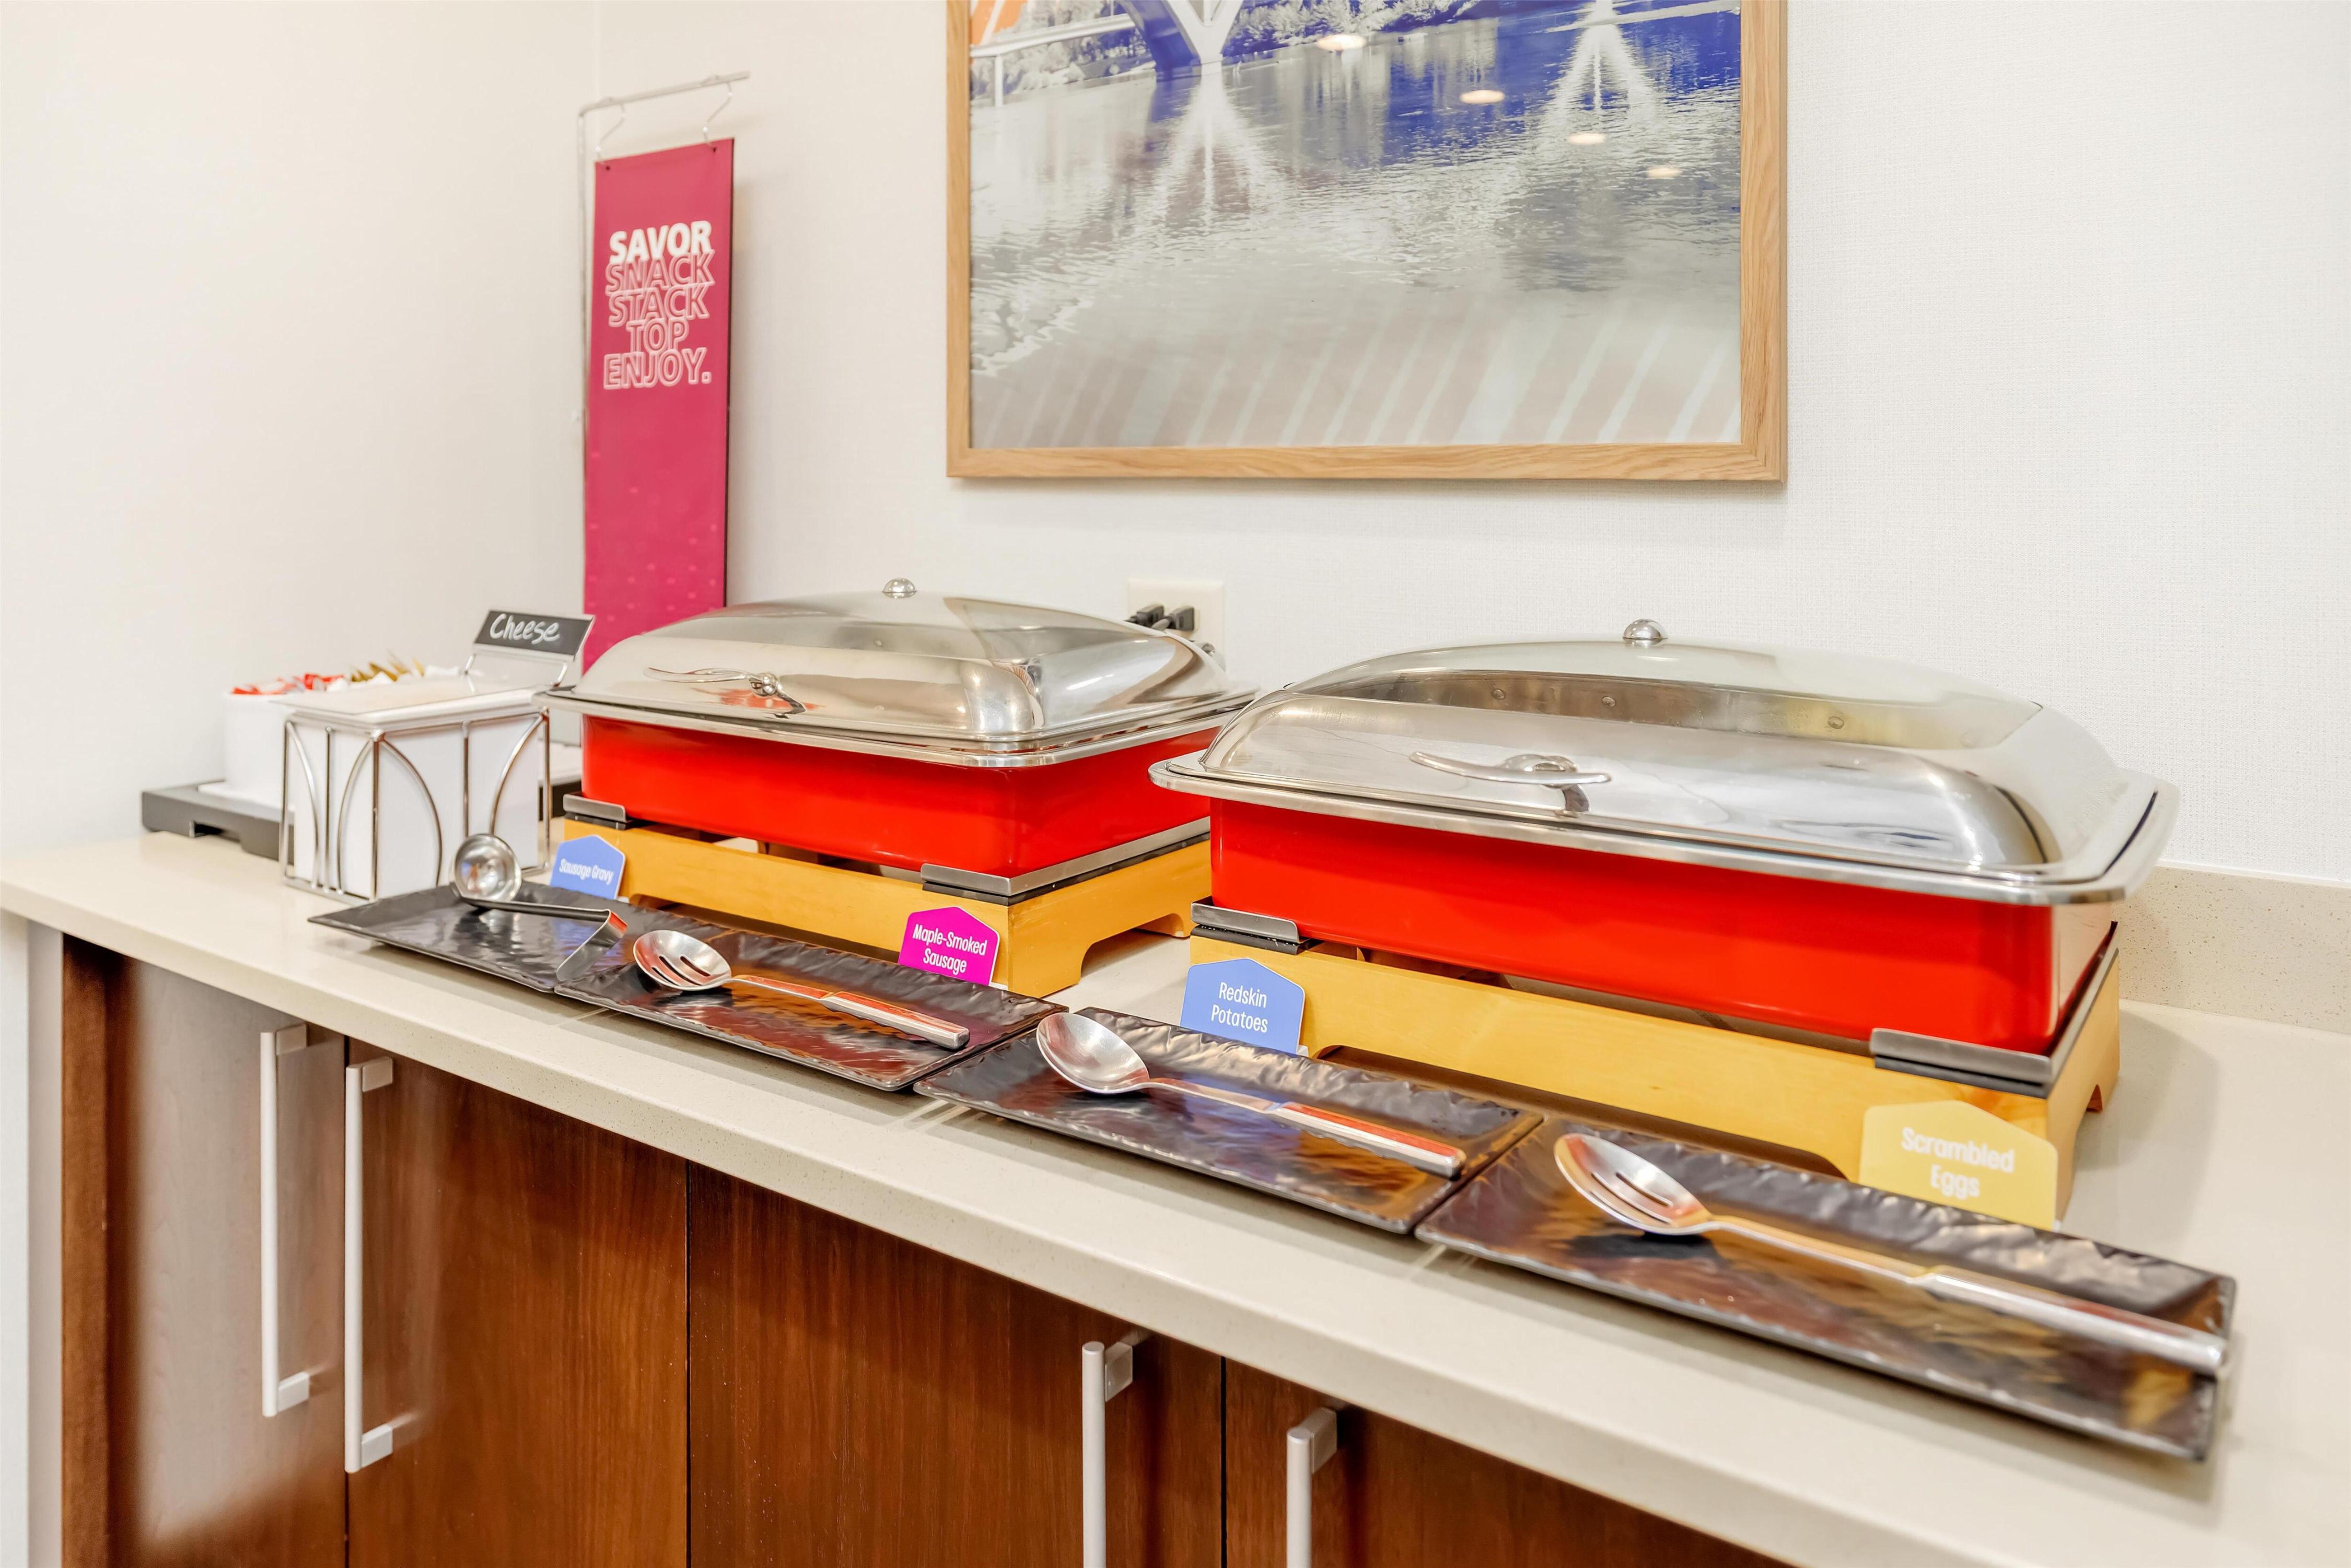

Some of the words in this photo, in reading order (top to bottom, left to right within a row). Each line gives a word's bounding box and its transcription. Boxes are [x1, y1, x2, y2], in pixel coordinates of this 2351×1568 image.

[609, 220, 712, 264] SAVOR
[605, 249, 715, 296] SNACK
[608, 282, 710, 327] STACK
[625, 317, 689, 354] TOP
[603, 347, 712, 390] ENJOY.
[490, 613, 561, 645] Cheese
[559, 858, 591, 881] Sausage
[591, 864, 614, 885] Gravy
[912, 923, 988, 956] Maple-Smoked
[923, 947, 967, 976] Sausage
[1218, 981, 1267, 1009] Redskin
[1211, 1004, 1268, 1033] Potatoes
[1901, 1126, 2015, 1173] Scrambled
[1930, 1164, 1980, 1200] Eggs
